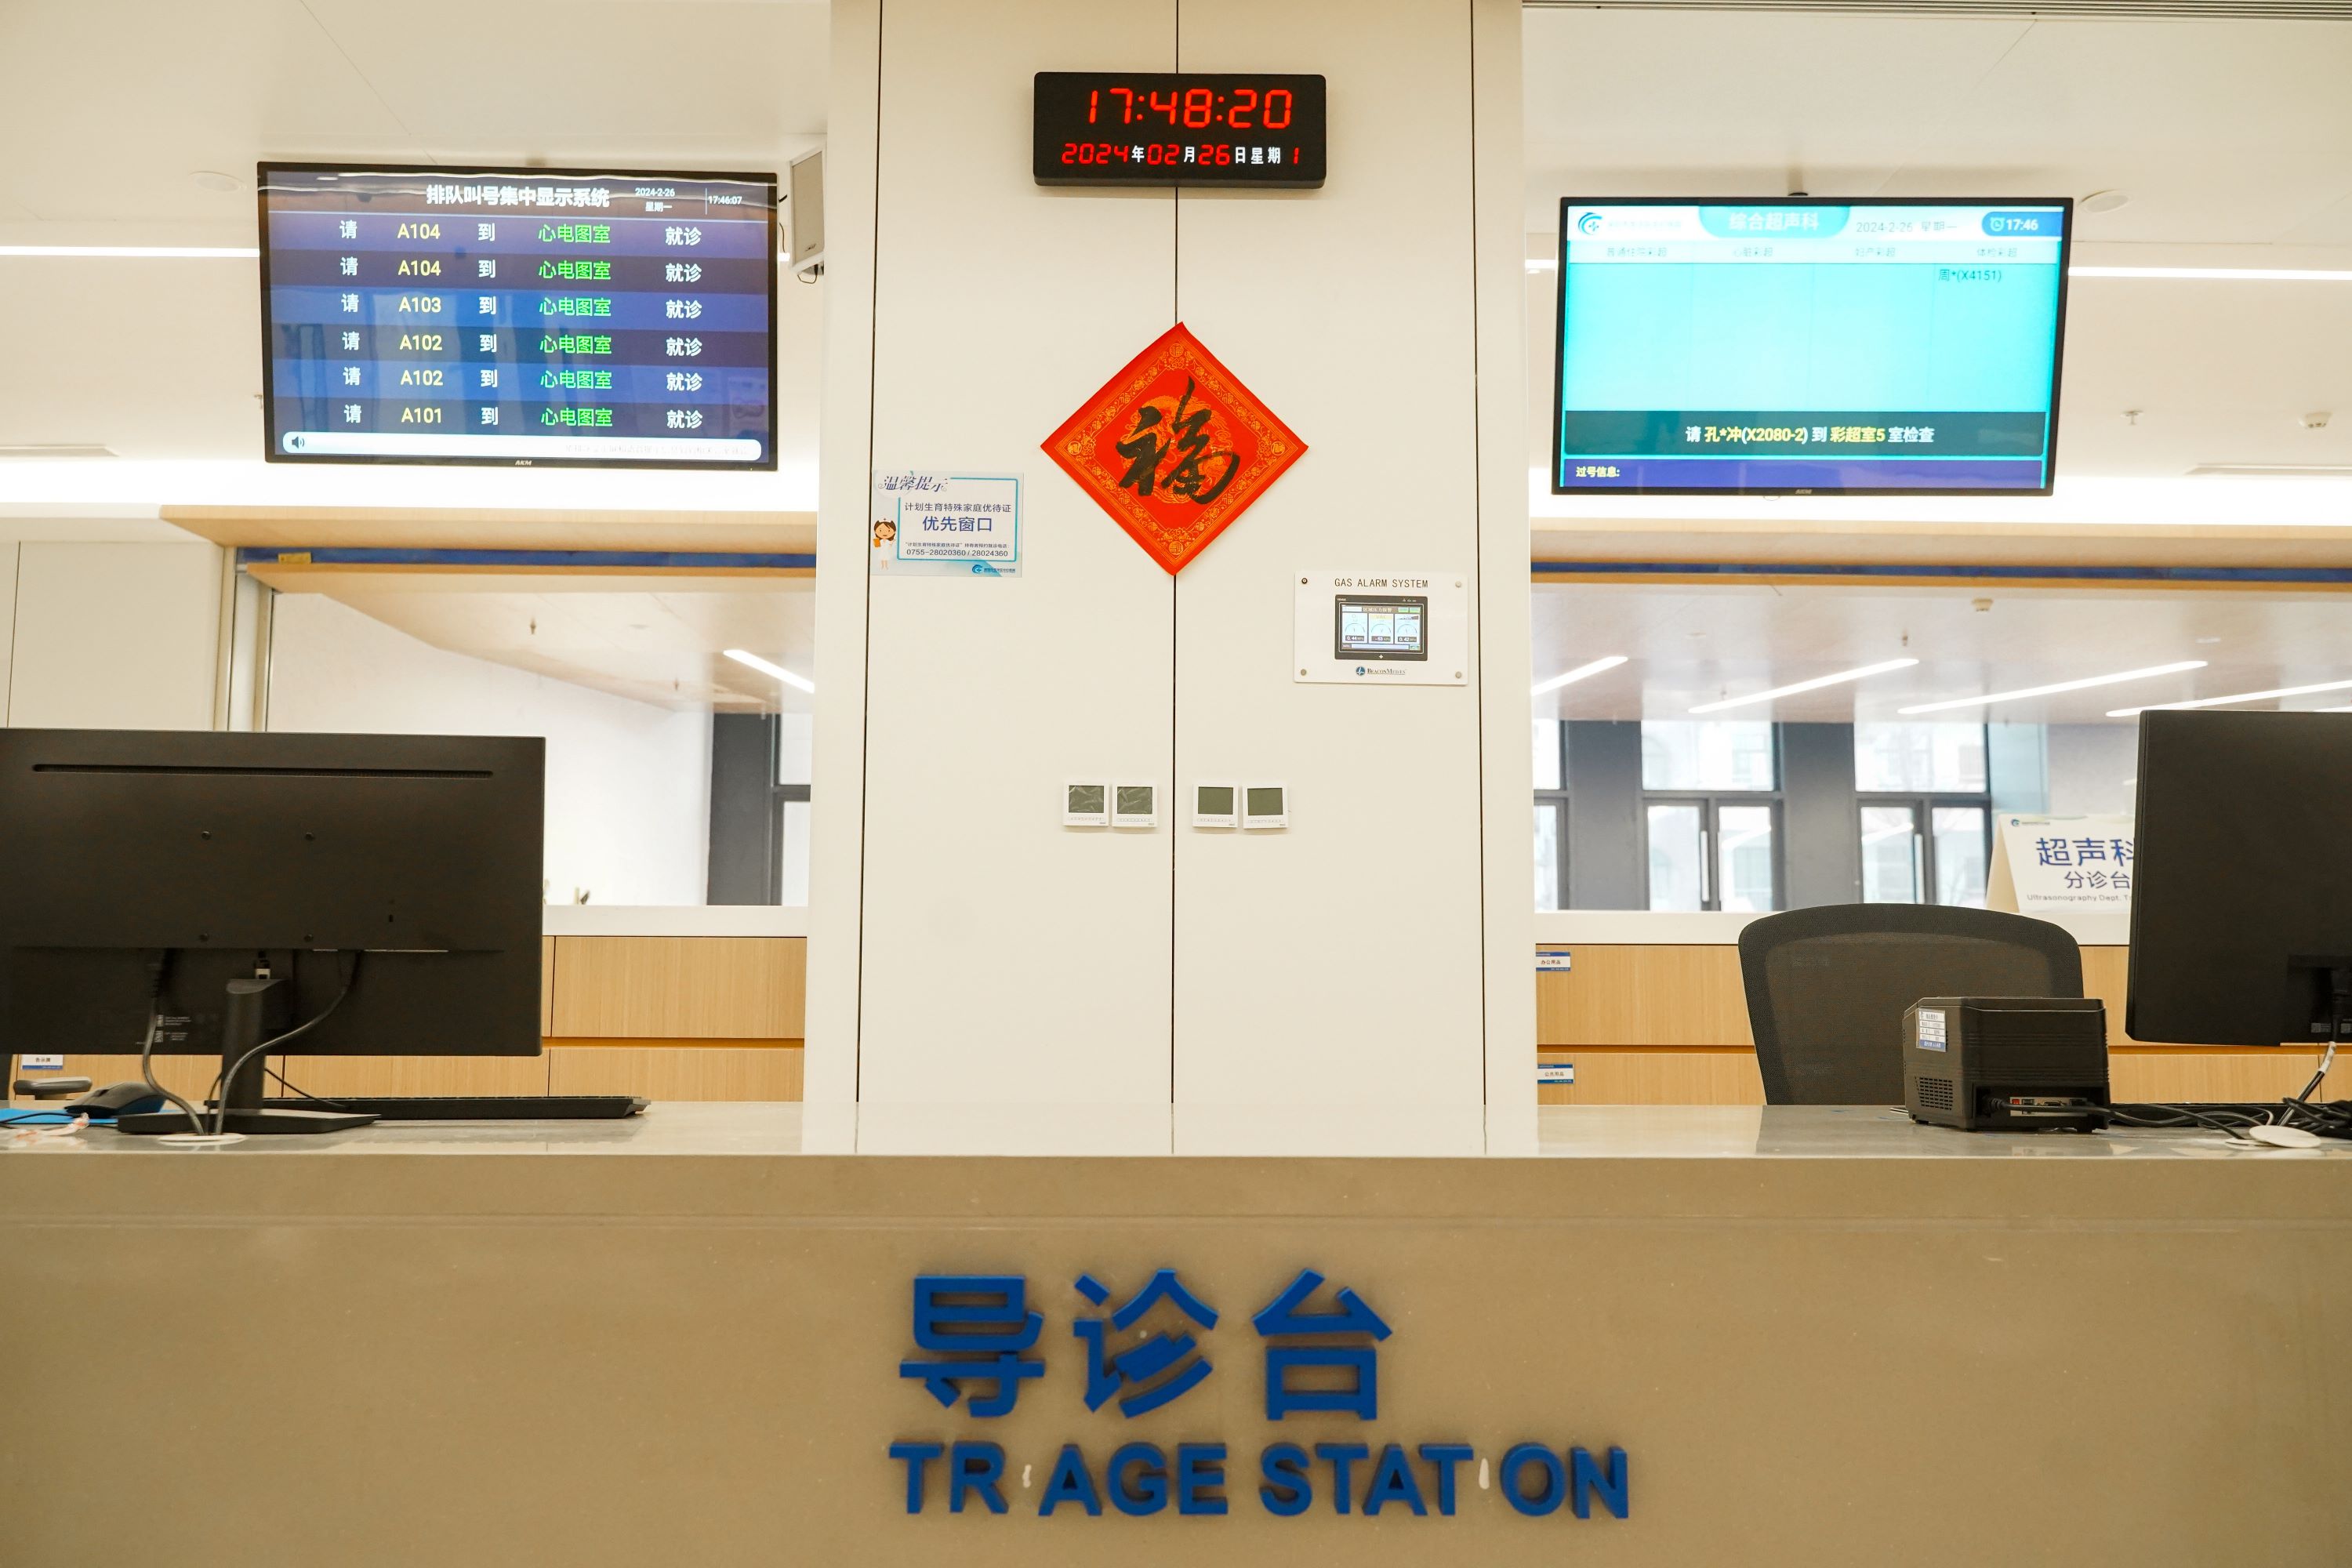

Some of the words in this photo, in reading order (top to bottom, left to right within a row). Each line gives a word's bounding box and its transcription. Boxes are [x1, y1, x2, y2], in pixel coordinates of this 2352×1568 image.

[1089, 88, 1292, 129] 17:48:20
[426, 184, 611, 207] 排队叫号集中显示系统
[635, 187, 675, 197] 2024-2-26
[708, 195, 742, 205] 17:46:07
[645, 201, 673, 212] 星期一
[1729, 212, 1819, 231] 综合超声科
[1857, 220, 1914, 234] 2024-2-26
[1920, 220, 1957, 231] 星期一
[2007, 219, 2038, 230] 17:46
[339, 220, 357, 238] 请
[397, 223, 440, 239] A104
[478, 223, 495, 241] 到
[539, 223, 610, 244] 心电图室
[666, 227, 702, 245] 就诊
[340, 256, 358, 275] 请
[398, 260, 441, 276] A104
[479, 260, 495, 278] 到
[539, 260, 611, 281] 心电图室
[666, 263, 702, 282] 就诊
[341, 293, 359, 312] 请
[399, 296, 441, 312] A103
[479, 296, 496, 314] 到
[538, 297, 611, 316] 心电图室
[666, 299, 702, 318] 就诊
[342, 332, 360, 350] 请
[400, 335, 442, 350] A102
[480, 334, 497, 352] 到
[539, 335, 612, 354] 心电图室
[666, 337, 702, 356] 就诊
[343, 367, 361, 385] 请
[401, 370, 443, 386] A102
[481, 369, 497, 387] 到
[539, 370, 612, 389] 心电图室
[666, 372, 702, 391] 就诊
[344, 405, 361, 423] 请
[401, 408, 441, 423] A101
[481, 407, 498, 425] 到
[540, 408, 612, 426] 心电图室
[667, 410, 702, 428] 就诊
[1114, 376, 1241, 506] 福
[1686, 426, 1701, 442] 请
[1812, 426, 1827, 442] 到
[1830, 426, 1885, 442] 彩超室5
[1888, 426, 1934, 442] 室检查
[878, 476, 948, 492] 温馨提示
[905, 503, 1011, 512] 计划生育特殊家庭优待证
[923, 516, 992, 532] 优先窗口
[1392, 579, 1428, 588] SYSTEM
[2036, 837, 2134, 866] 超声科
[2064, 871, 2130, 889] 分诊台
[899, 1269, 1392, 1421] 导诊台
